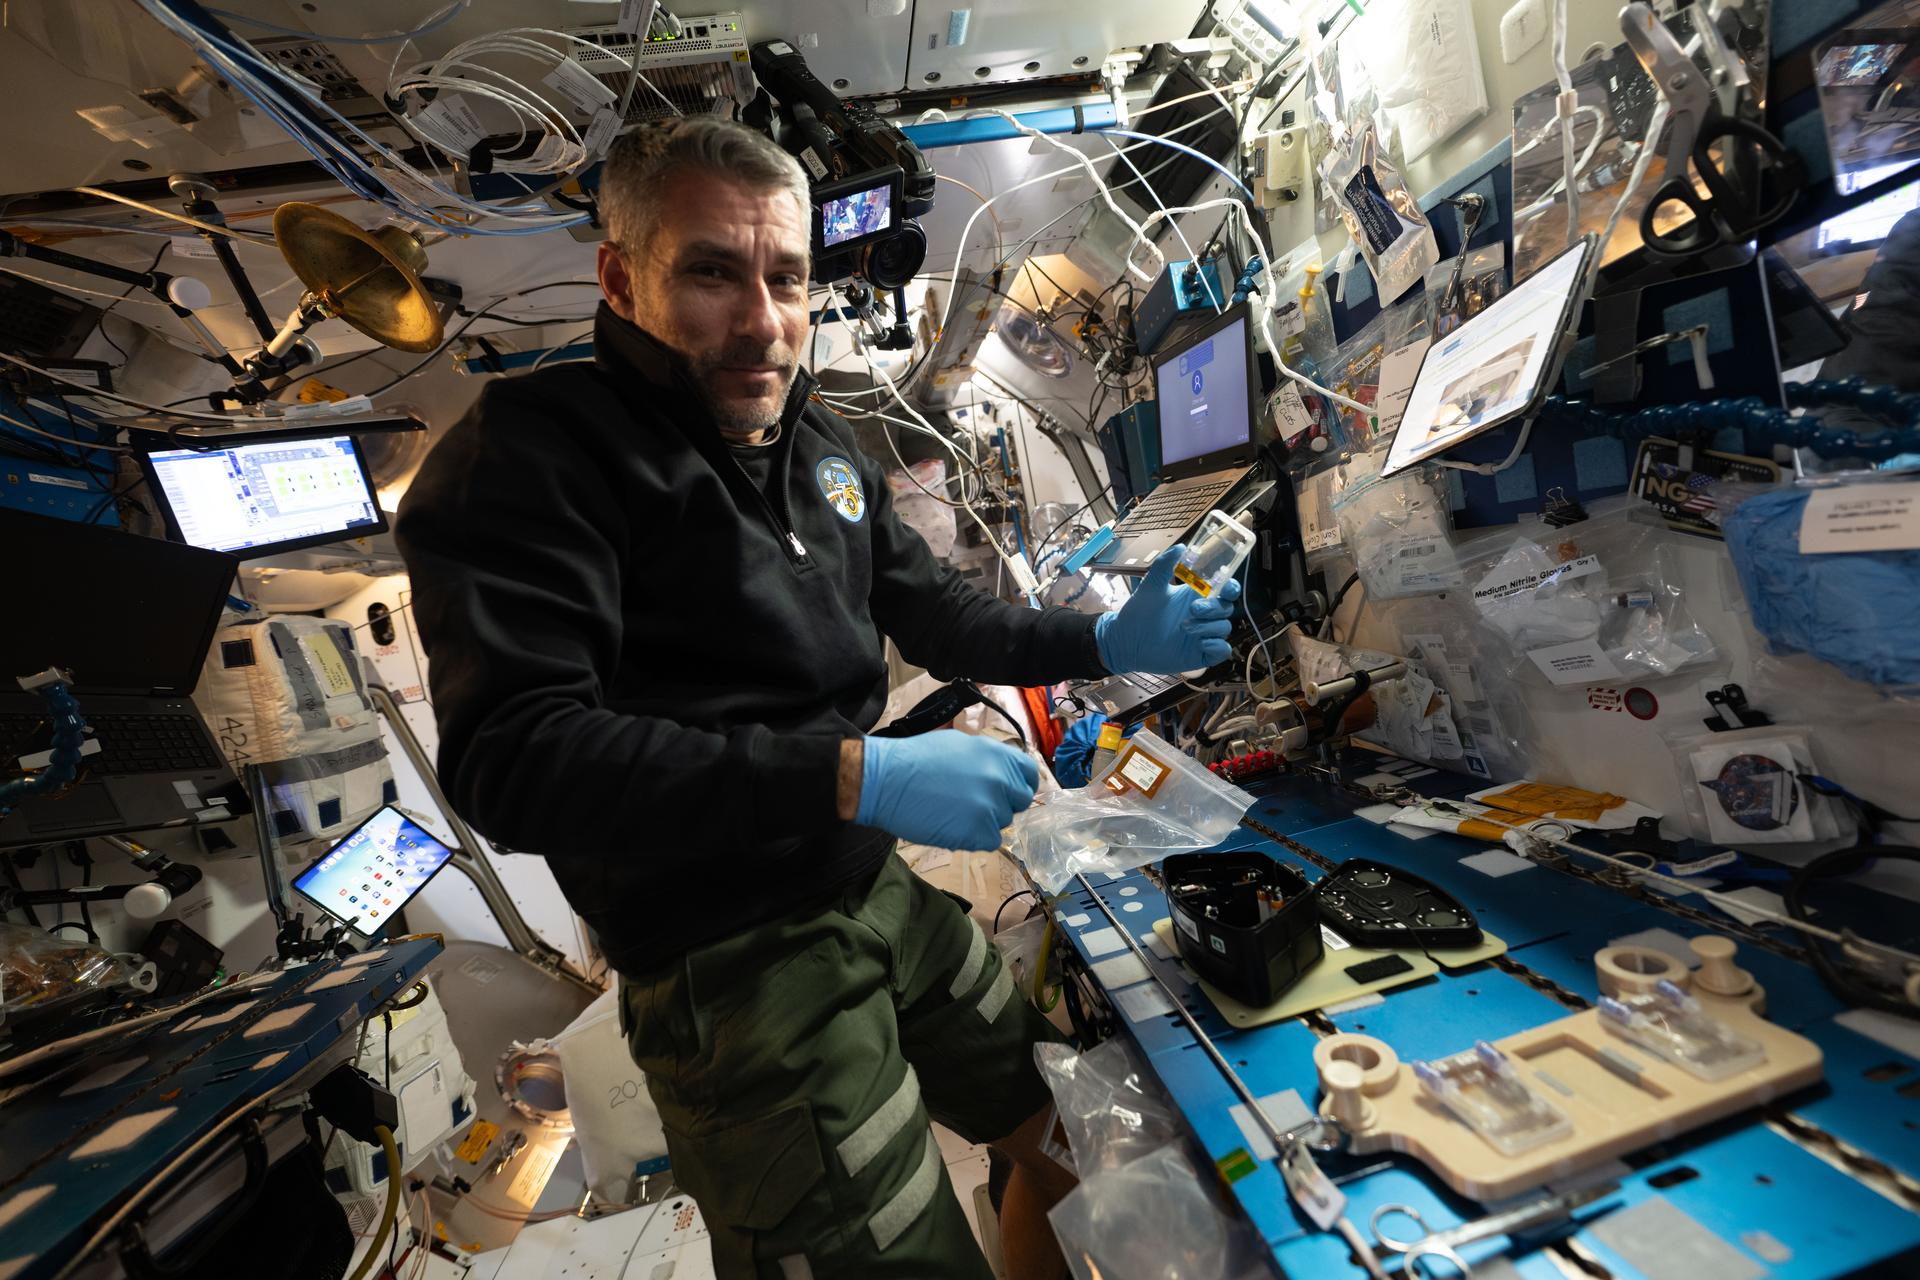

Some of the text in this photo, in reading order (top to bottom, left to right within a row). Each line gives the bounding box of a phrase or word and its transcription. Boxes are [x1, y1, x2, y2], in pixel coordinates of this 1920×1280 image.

[714, 41, 744, 49] FORTINET
[1475, 584, 1507, 599] Medium
[1510, 573, 1537, 589] Nitrile
[1540, 564, 1572, 579] Gloves
